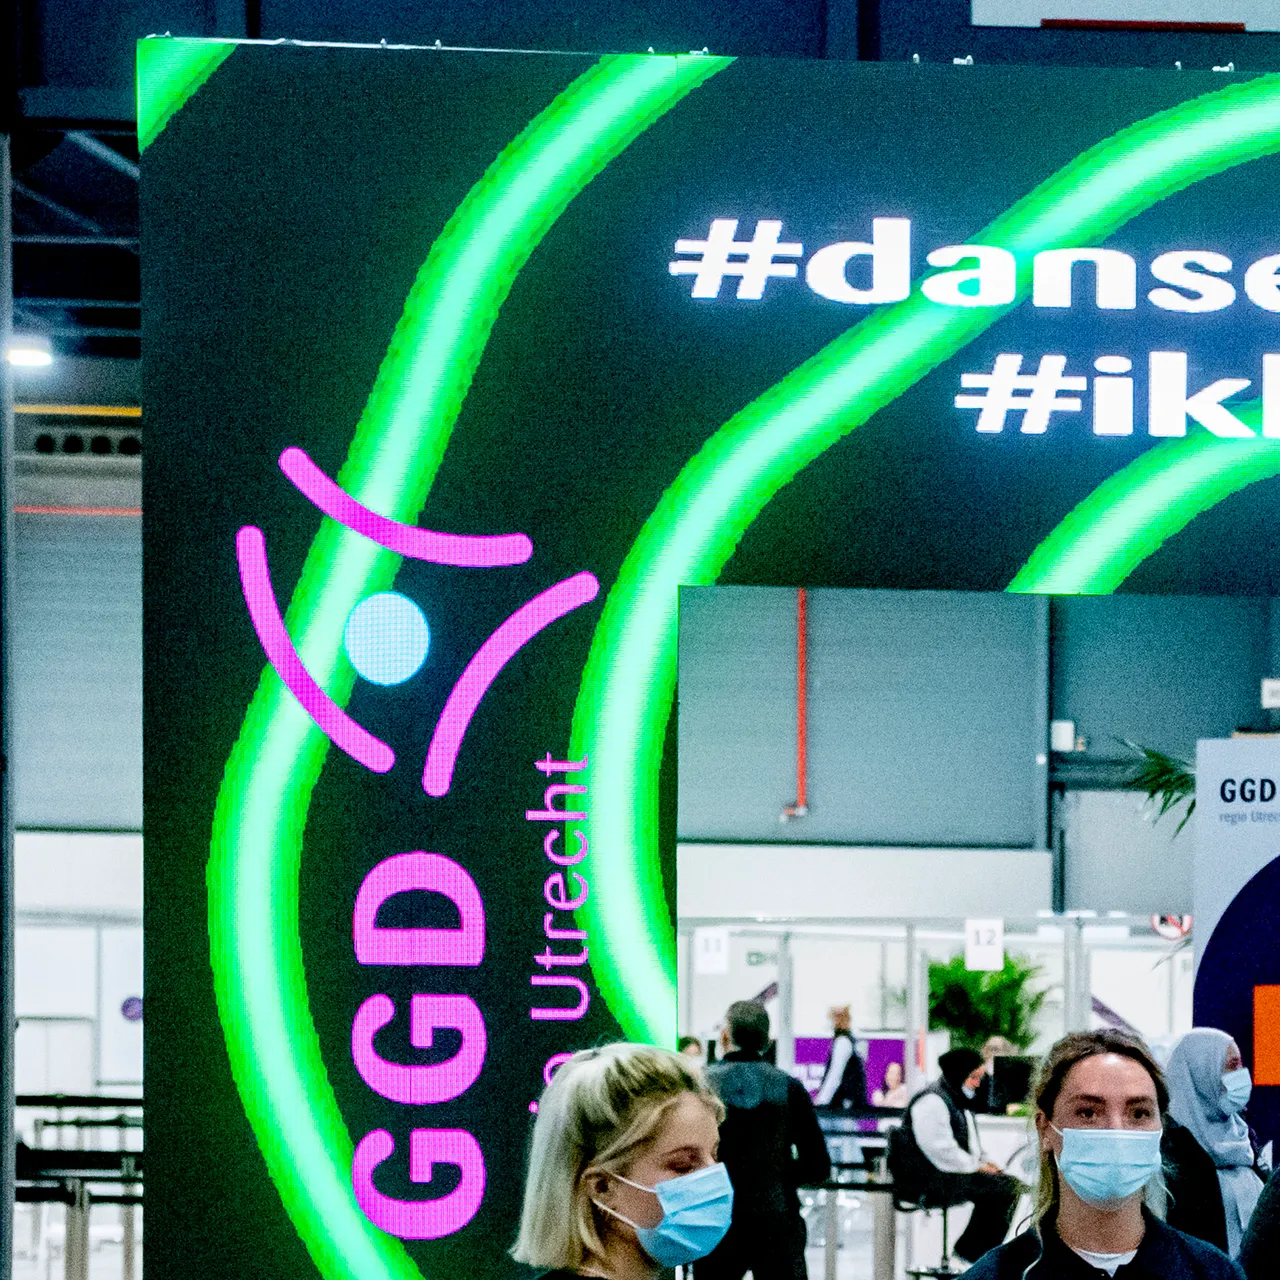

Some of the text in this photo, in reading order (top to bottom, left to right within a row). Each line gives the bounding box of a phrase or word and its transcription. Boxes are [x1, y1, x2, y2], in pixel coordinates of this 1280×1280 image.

[1220, 778, 1276, 803] GGD
[1219, 811, 1247, 825] regio
[525, 752, 590, 1021] Utrecht
[974, 928, 997, 946] 12
[351, 850, 487, 1240] GGD
